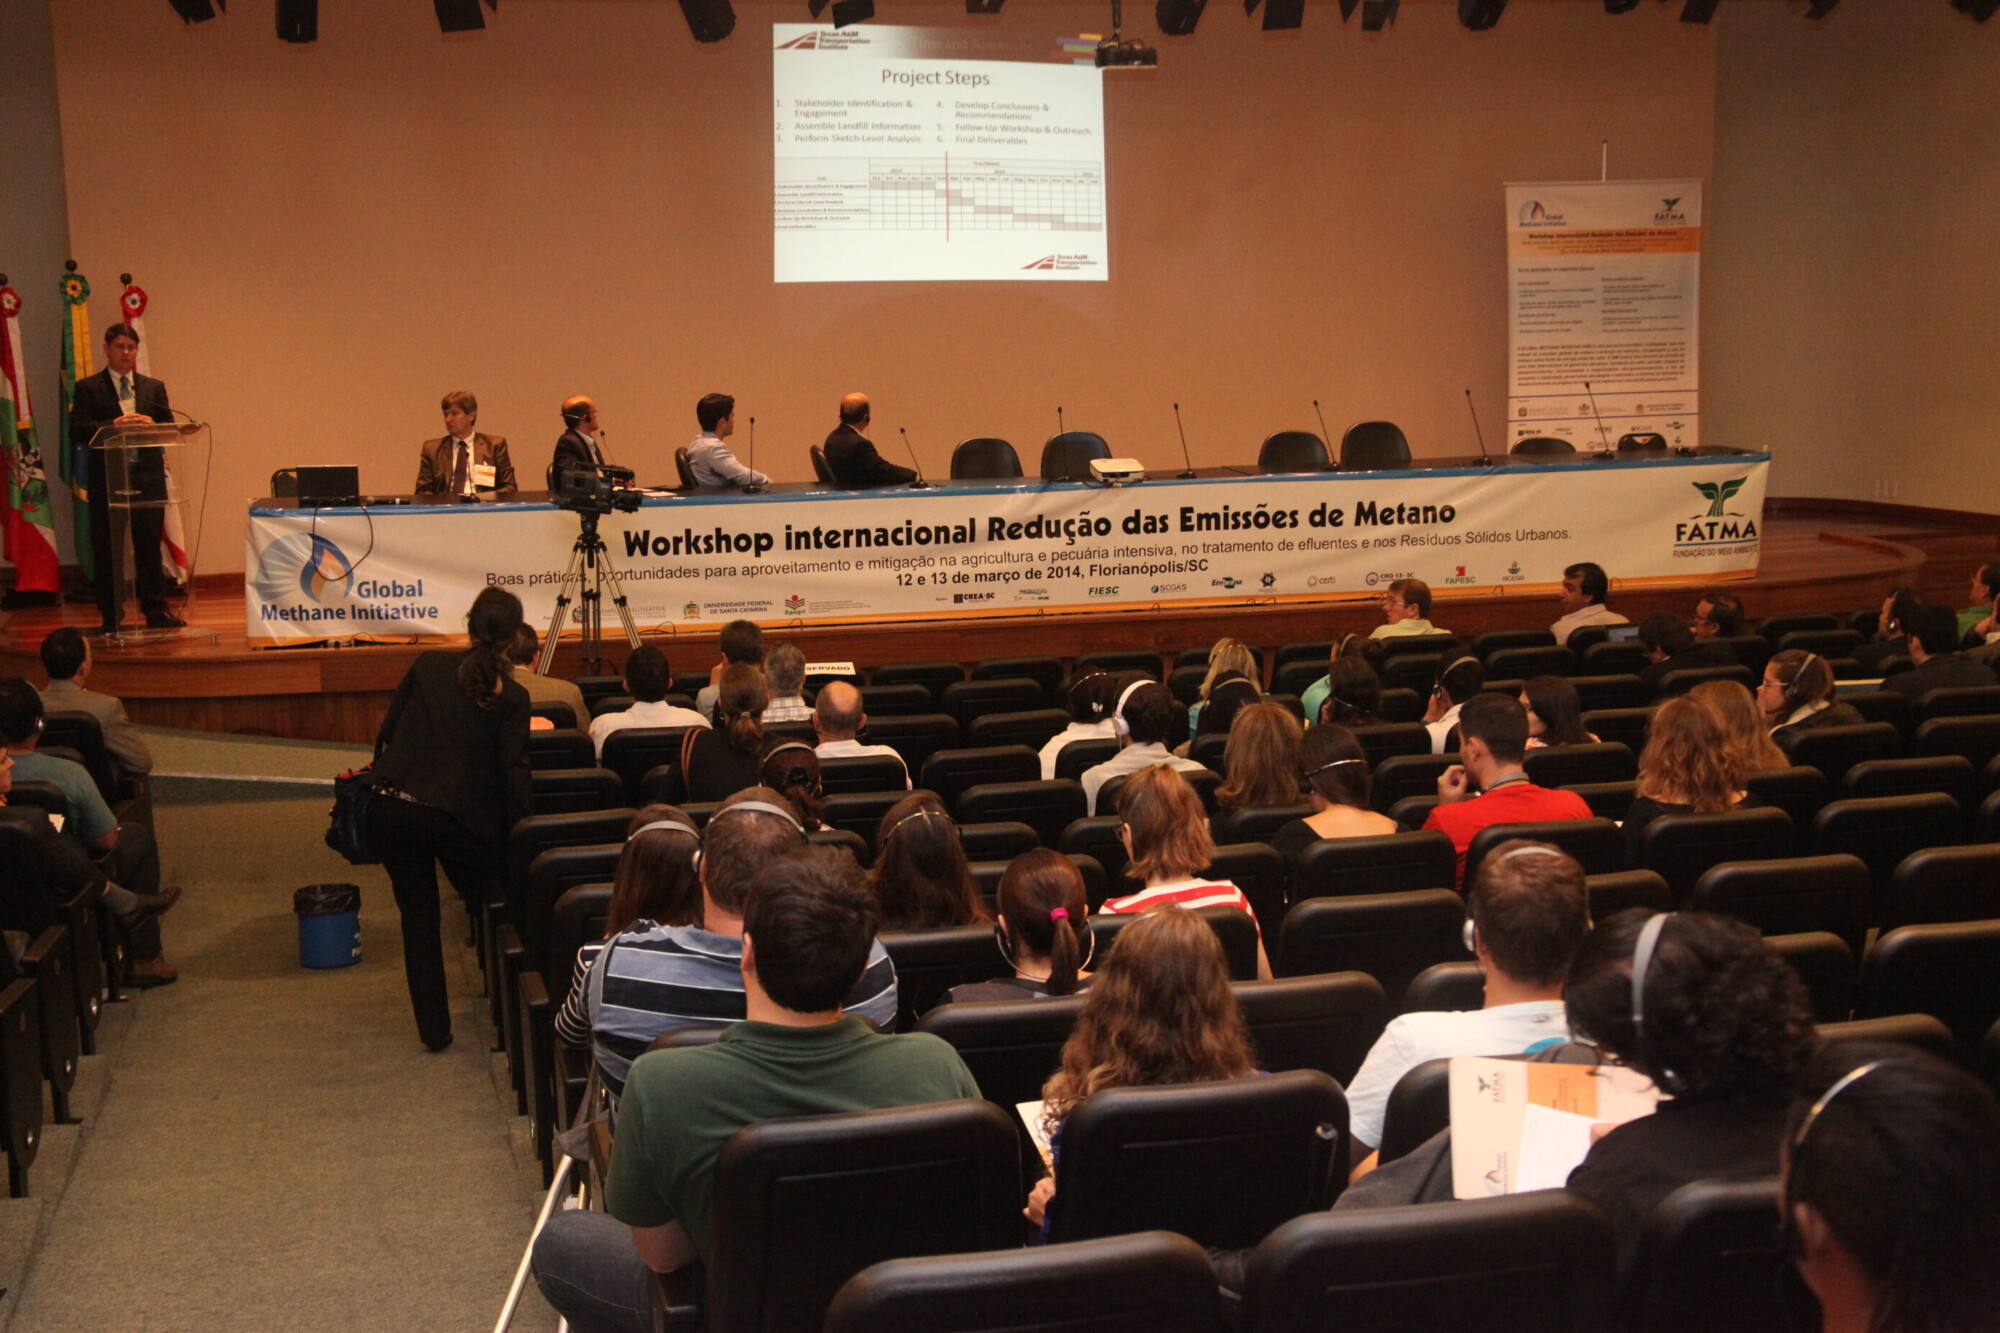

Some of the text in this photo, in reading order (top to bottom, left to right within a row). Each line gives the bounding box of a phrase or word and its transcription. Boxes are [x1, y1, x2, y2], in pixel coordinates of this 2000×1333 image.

[881, 69, 990, 87] Project Steps
[794, 99, 844, 108] Stakeholder
[847, 99, 903, 108] Identification
[906, 100, 913, 108] &
[955, 101, 989, 110] Develop
[991, 102, 1040, 111] Conclusions
[794, 110, 847, 118] Engagement
[955, 111, 1032, 120] Recommendations
[795, 122, 835, 130] Assemble
[838, 122, 868, 130] Landfill
[871, 123, 921, 131] Information
[955, 123, 998, 133] Follow-Up
[1000, 124, 1042, 134] Workshop
[1053, 126, 1091, 135] Outreach
[795, 134, 829, 142] Perform
[832, 134, 883, 142] Sketch-Level
[887, 135, 921, 143] Analysis
[956, 135, 975, 143] Final
[977, 136, 1027, 145] Deliverables
[1654, 213, 1685, 221] FATMA
[624, 501, 1456, 557] Workshop internacional Redução das Emissões de Metano
[1676, 520, 1757, 542] FATMA
[486, 572, 524, 585] Boas
[704, 565, 737, 580] para
[742, 558, 851, 578] aproveitamento
[855, 560, 863, 570] e
[868, 554, 935, 572] mitigação
[940, 555, 957, 566] na
[961, 551, 1034, 568] agricultura
[1038, 552, 1047, 562] e
[1051, 547, 1109, 565] pecuária
[1113, 544, 1177, 559] intensiva,
[1182, 544, 1198, 555] no
[1202, 538, 1274, 554] tratamento
[1277, 538, 1294, 552] de
[1298, 536, 1357, 552] efluentes
[1361, 539, 1370, 549] e
[1374, 537, 1396, 548] nos
[1400, 532, 1461, 547] Resíduos
[1465, 530, 1512, 544] Sólidos
[1515, 528, 1572, 542] Urbanos.
[1673, 548, 1705, 558] FUNDAÇÃO
[1707, 548, 1716, 556] DO
[1717, 547, 1732, 555] MEIO
[896, 559, 1208, 586] 12 e 13 de março de 2014, Florianópolis/SC
[357, 579, 423, 599] Global
[1088, 586, 1119, 595] FIESC
[704, 601, 745, 609] UNIVERSIDADE
[741, 605, 768, 613] CATARINA
[260, 603, 438, 622] Methane Initiative
